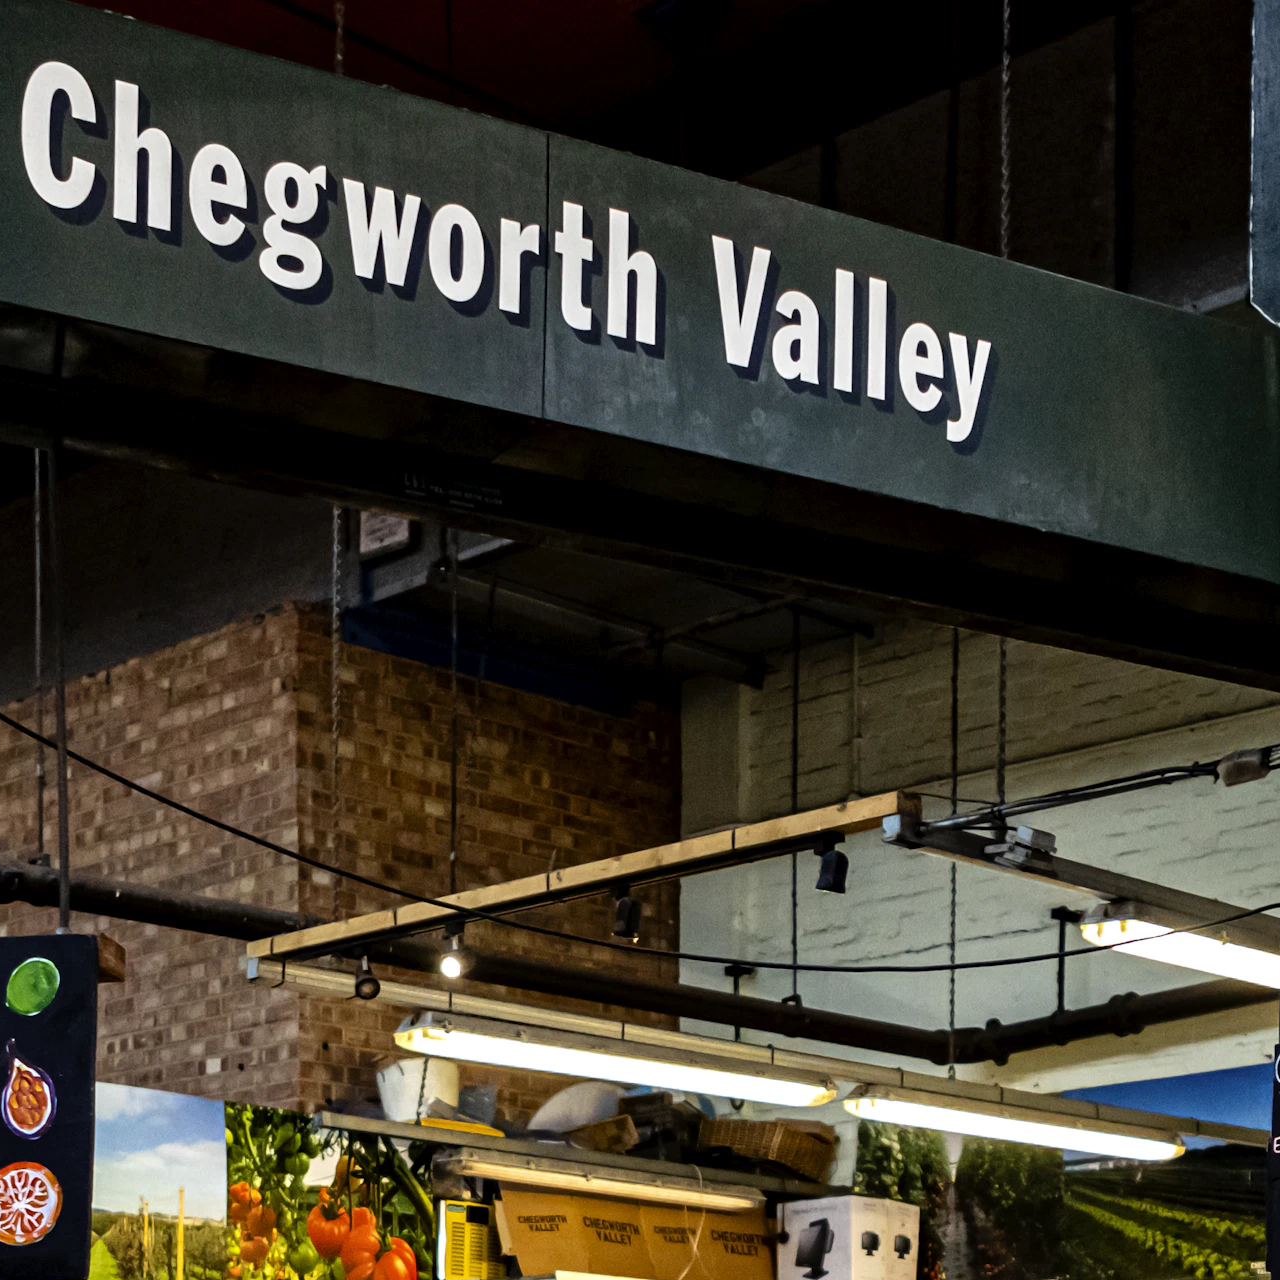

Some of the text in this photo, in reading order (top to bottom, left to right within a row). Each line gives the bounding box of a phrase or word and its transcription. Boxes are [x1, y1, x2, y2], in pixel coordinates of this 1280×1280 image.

[22, 61, 993, 443] Chegworth Valley
[517, 1215, 567, 1226] CHEGWORTH
[529, 1221, 560, 1232] VALLEY
[582, 1216, 640, 1235] CHEGWORTH
[596, 1230, 633, 1246] VALLEY
[711, 1229, 765, 1247] CHEGWORTH
[723, 1242, 759, 1257] VALLEY
